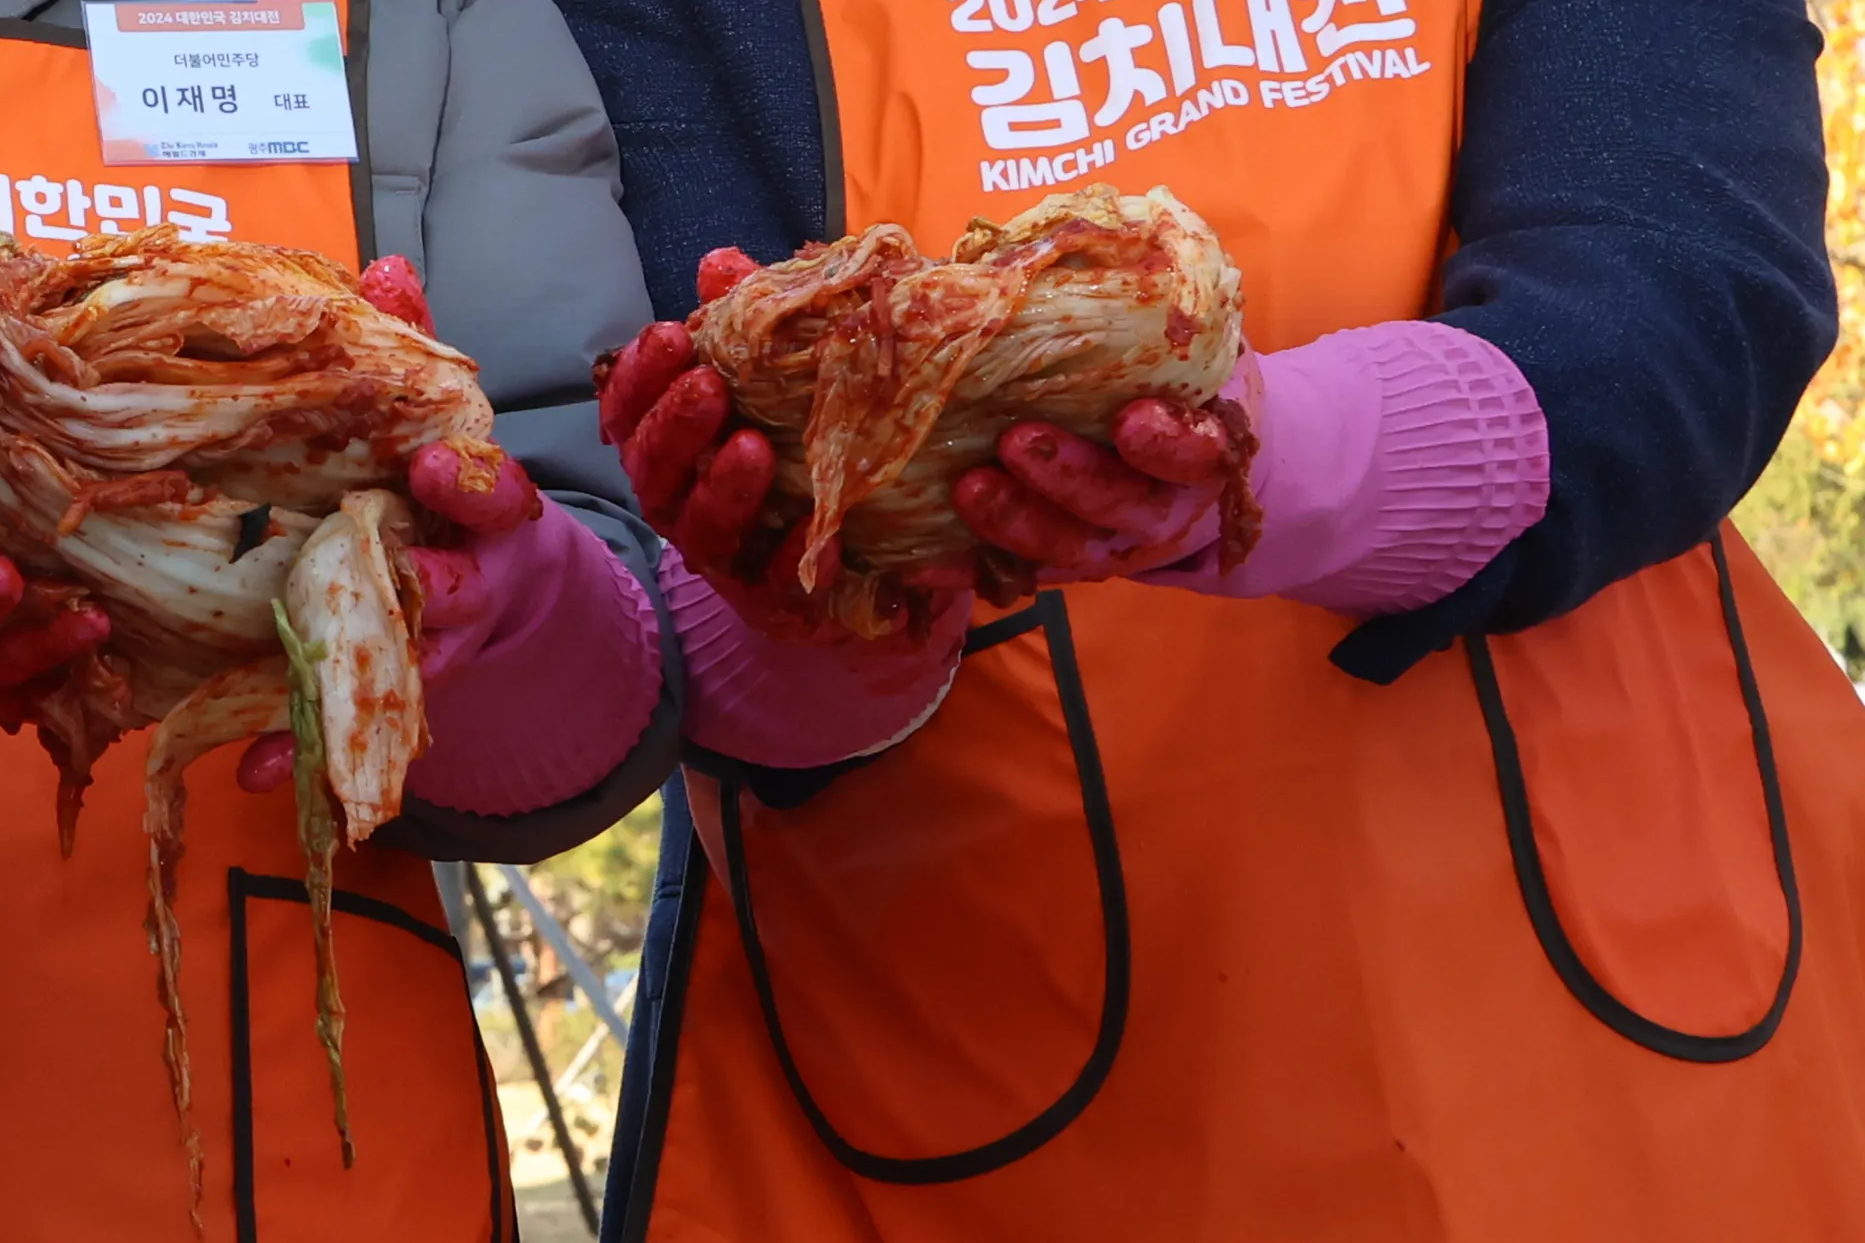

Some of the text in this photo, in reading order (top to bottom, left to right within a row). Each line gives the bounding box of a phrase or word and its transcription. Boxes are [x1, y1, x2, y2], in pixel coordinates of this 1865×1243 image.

[138, 9, 280, 25] 2024 대한민국 김치대전
[173, 52, 260, 69] 더불어민주당
[142, 84, 311, 115] 이재명 대표
[978, 46, 1433, 193] KIMCHI GRAND FESTIVAL
